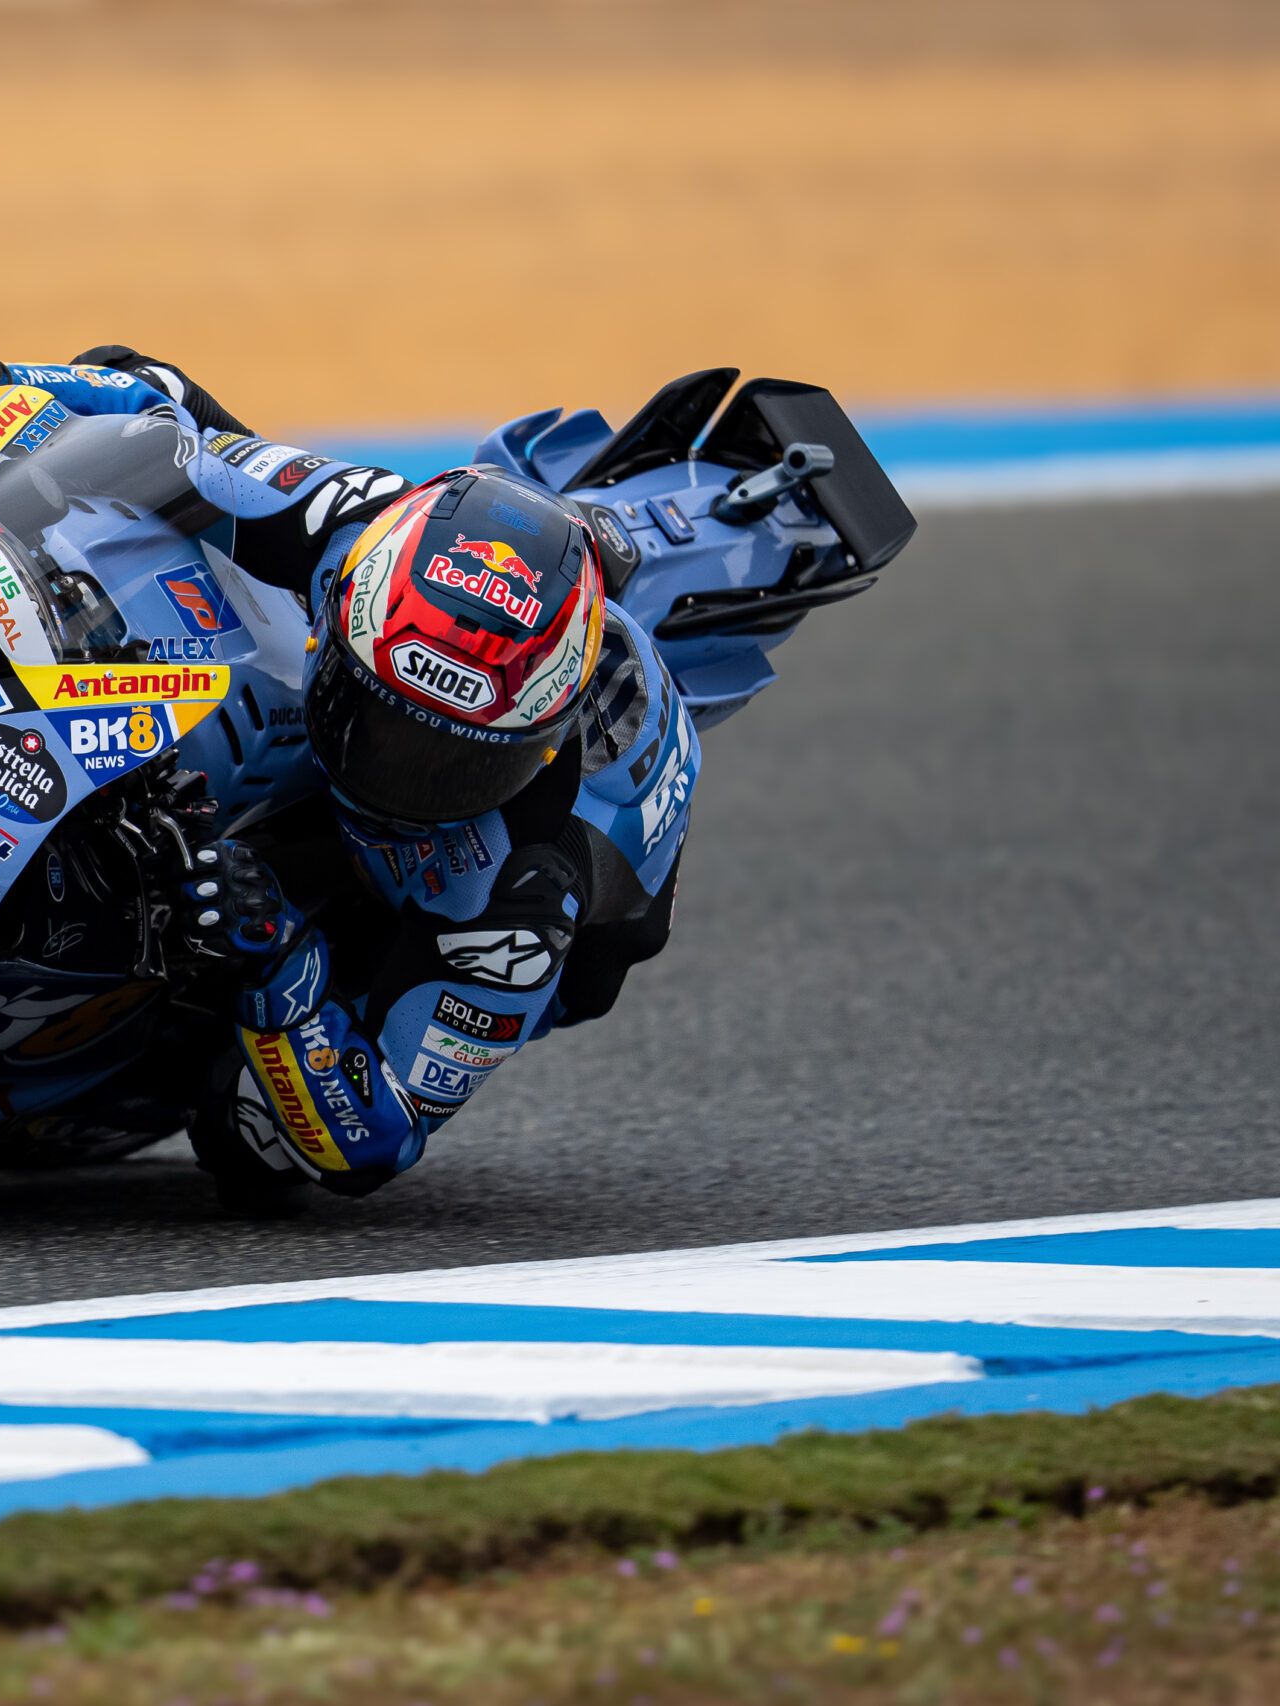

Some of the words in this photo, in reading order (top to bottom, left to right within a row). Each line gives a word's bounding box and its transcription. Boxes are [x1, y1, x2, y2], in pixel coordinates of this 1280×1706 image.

[12, 400, 70, 454] ALEX
[351, 549, 383, 641] verleal
[423, 553, 489, 600] Red
[482, 569, 543, 629] Bull
[147, 636, 217, 661] ALEX
[53, 667, 211, 701] Antangin
[402, 650, 483, 705] SHOEI
[519, 645, 583, 723] verleal
[269, 707, 305, 727] DUCA
[353, 666, 396, 707] GIVES
[403, 704, 440, 728] YOU
[450, 720, 512, 744] WINGS
[70, 710, 161, 755] BK8
[84, 756, 126, 770] NEWS
[437, 1011, 488, 1038] RIDERS
[440, 994, 493, 1029] BOLD
[459, 1043, 491, 1058] AUS
[254, 1033, 326, 1154] Antangin
[320, 1079, 370, 1142] NEWS
